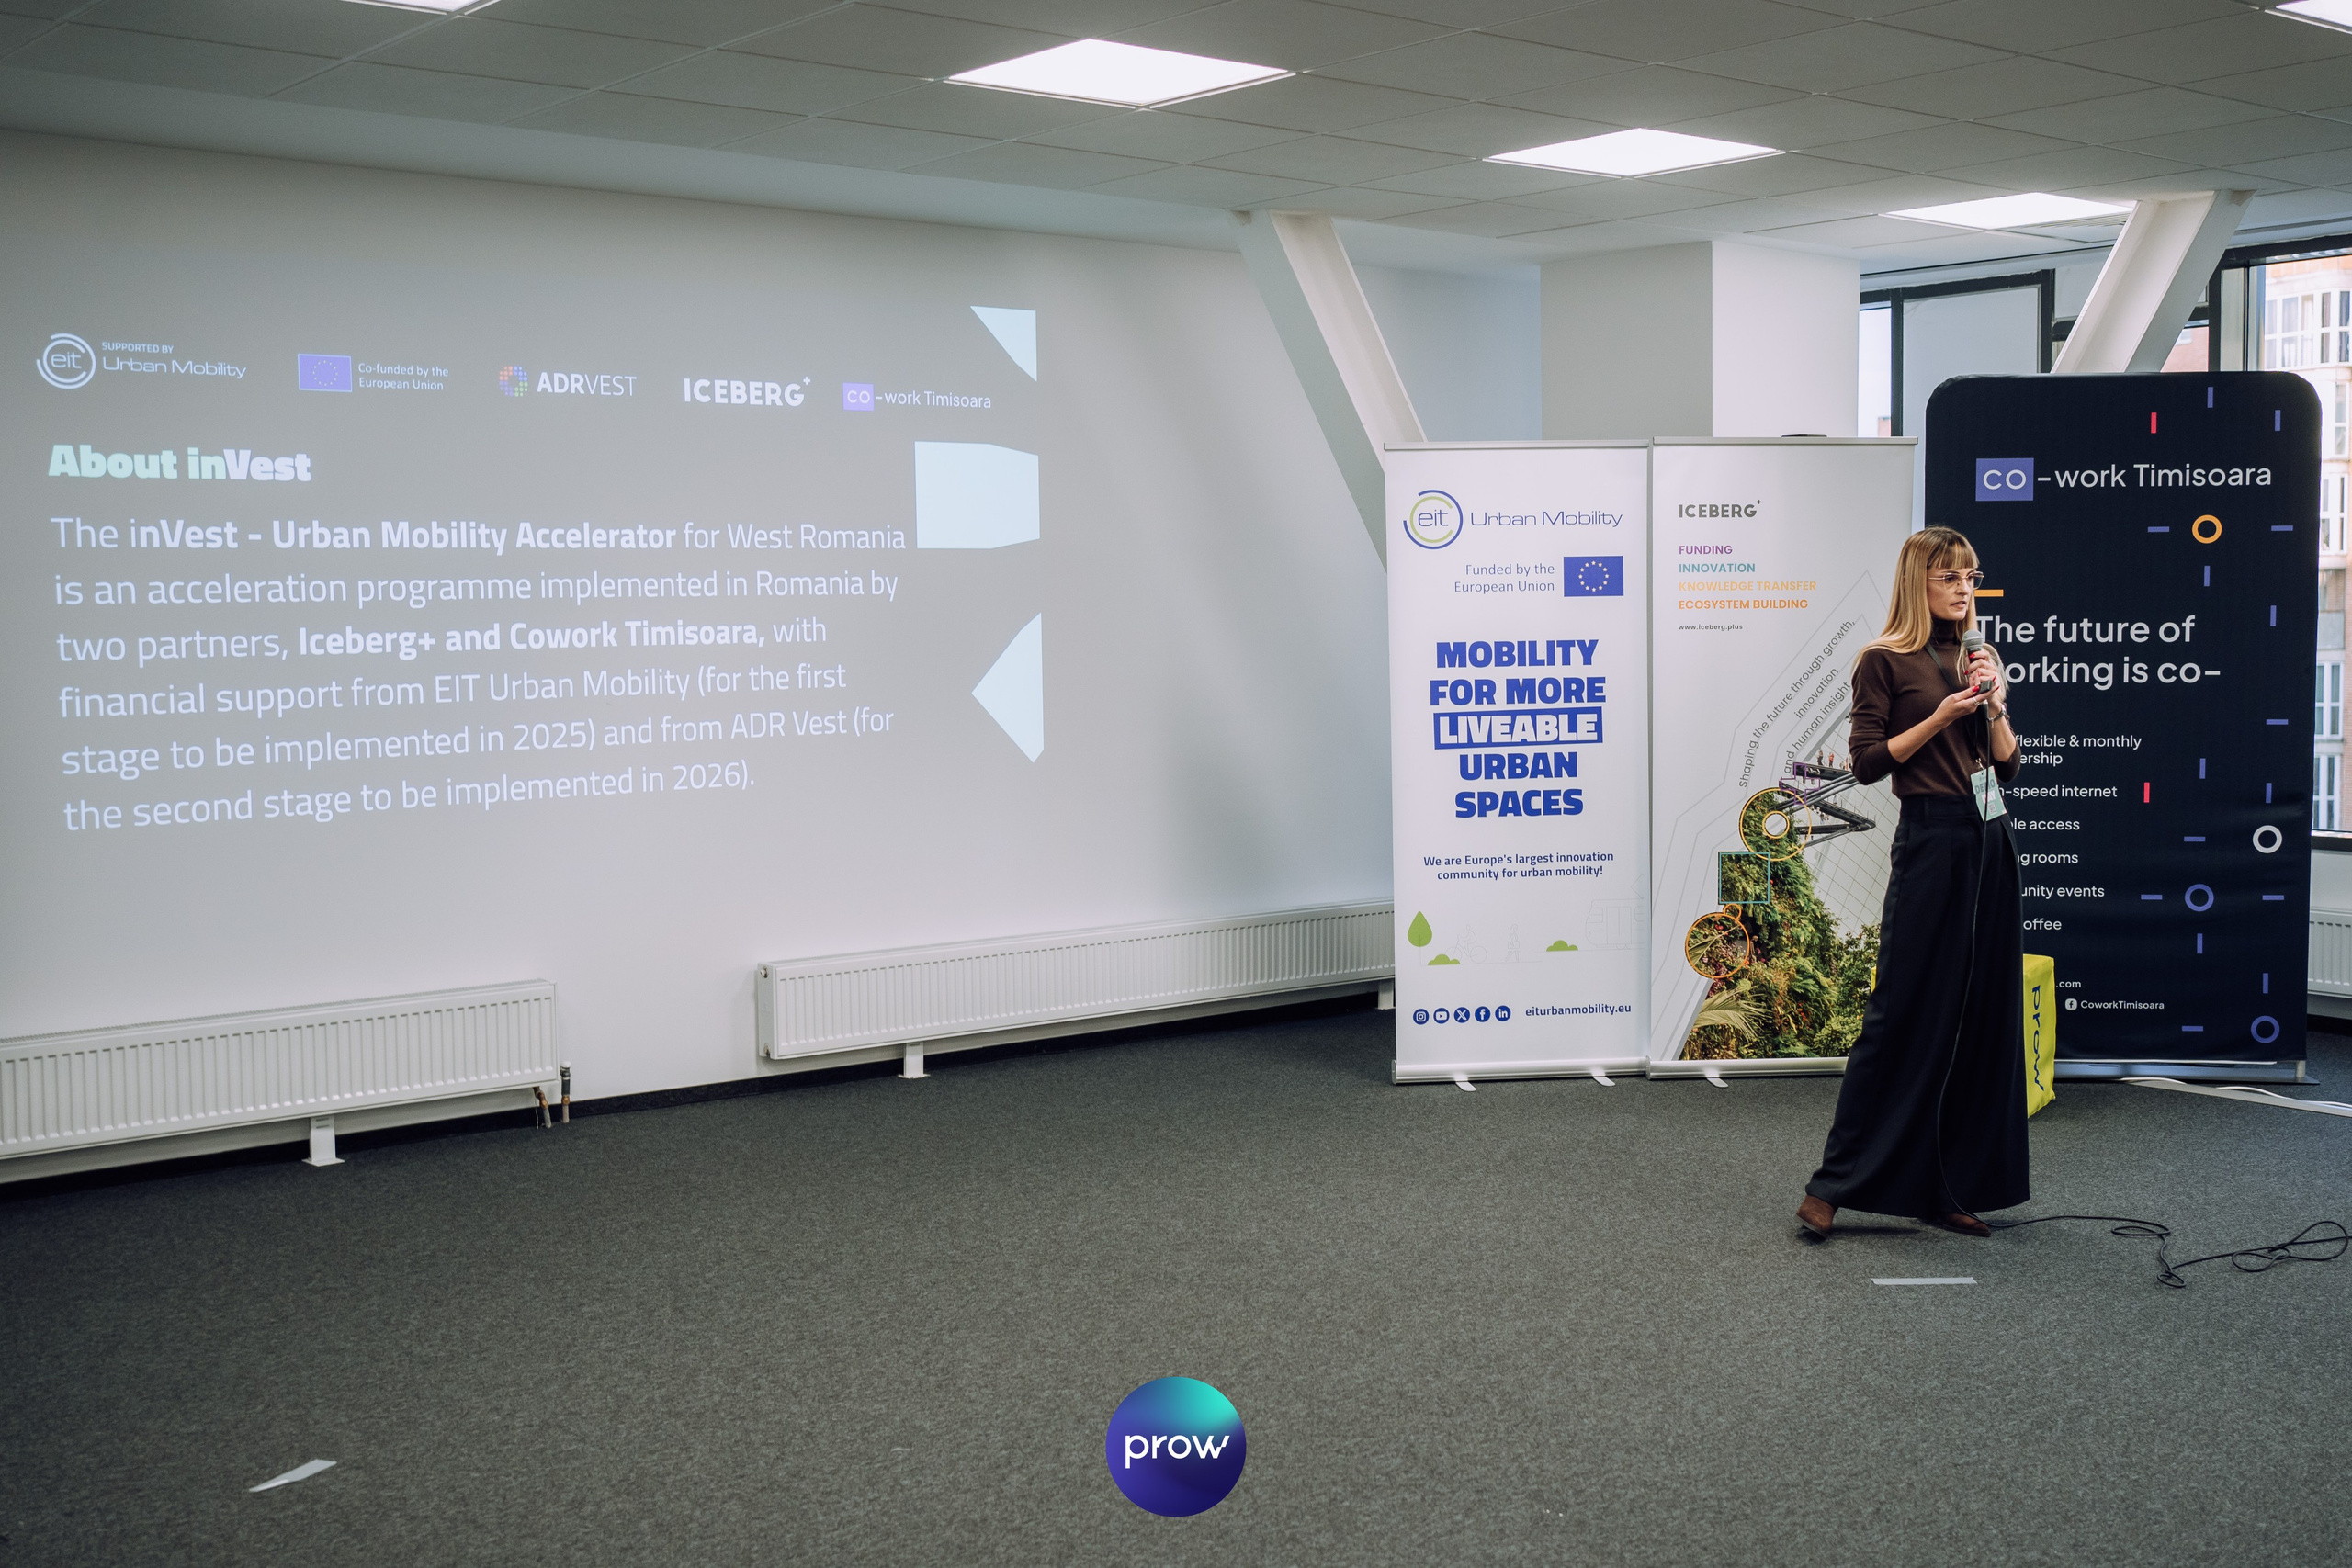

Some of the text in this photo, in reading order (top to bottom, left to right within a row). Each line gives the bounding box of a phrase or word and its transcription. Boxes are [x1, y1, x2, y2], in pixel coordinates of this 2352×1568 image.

[101, 342, 174, 354] SUPPORTED BY
[51, 350, 82, 369] eit
[103, 356, 246, 378] Urban Mobility
[358, 363, 448, 378] Co-funded by the
[359, 378, 443, 390] European Union
[924, 390, 991, 408] Timisoara
[49, 445, 311, 481] About inVest
[2133, 463, 2272, 488] Timisoara
[1418, 509, 1623, 527] eit Urban Mobility
[51, 517, 119, 548] The
[130, 518, 238, 549] inVest
[273, 520, 371, 549] Urban
[381, 520, 507, 556] Mobility
[515, 522, 676, 549] Accelerator
[684, 522, 719, 548] for
[728, 524, 793, 548] West
[800, 525, 906, 549] Romania
[1679, 545, 1733, 555] FUNDING
[1465, 563, 1555, 577] Funded by the
[1679, 563, 1756, 573] INNOVATION
[55, 570, 899, 608] is an acceleration programme implemented in Romania by
[1454, 581, 1555, 594] European Union
[1679, 581, 1816, 592] KNOWLEDGE TRANSFER
[1679, 599, 1808, 610] ECOSYSTEM BUILDING
[1679, 624, 1743, 632] www.iceberg.plus
[1976, 615, 2196, 643] The future of
[57, 616, 826, 668] two partners, Iceberg+ and Cowork Timisoara, with
[1436, 639, 1599, 668] MOBILITY
[2005, 656, 2113, 691] orking
[2123, 656, 2148, 683] is
[59, 663, 847, 718] financial support from EIT Urban Mobility (for the first
[1430, 677, 1606, 705] FOR MORE
[1794, 667, 1839, 719] innovation
[1738, 620, 1856, 788] Shaping the future through growth,
[1439, 714, 1598, 744] LIVEABLE
[1783, 681, 1851, 774] and human insight
[62, 706, 895, 780] stage to be implemented in 2025) and from ADR Vest (for
[2069, 735, 2079, 747] &
[2083, 735, 2142, 750] monthly
[1459, 751, 1577, 781] URBAN
[2019, 751, 2063, 767] ership
[64, 759, 755, 830] the second stage to be implemented in 2026).
[1974, 779, 1996, 795] DEO
[2062, 785, 2118, 797] internet
[1454, 788, 1584, 818] SPACES
[2029, 820, 2080, 830] access
[1423, 851, 1614, 868] We are Europe's largest innovation
[2032, 853, 2078, 863] rooms
[1437, 865, 1603, 881] community for urban mobility!
[2057, 886, 2104, 897] events
[2023, 918, 2062, 930] offee
[1525, 1004, 1632, 1016] eiturbanmobility.eu
[2080, 1000, 2165, 1010] CoworkTimisoara
[2032, 985, 2044, 1092] prow
